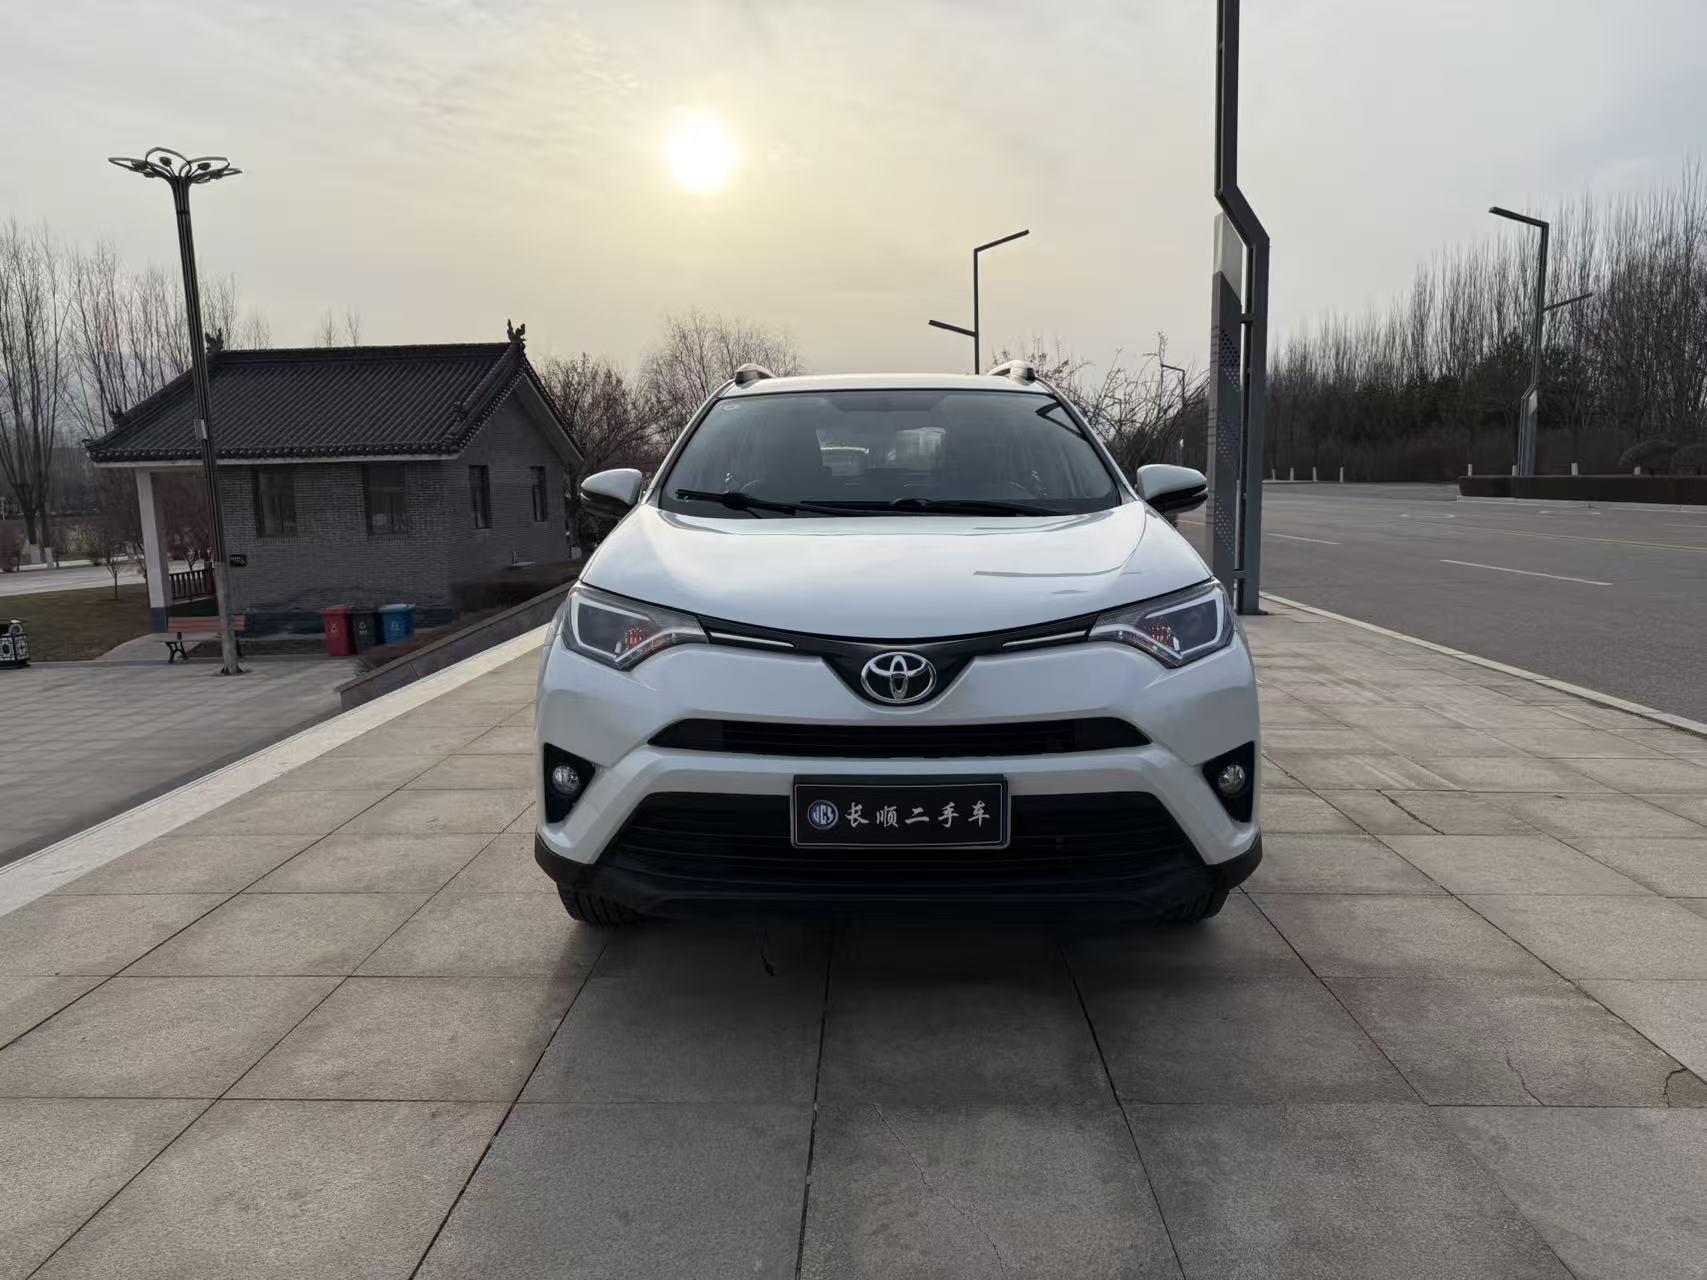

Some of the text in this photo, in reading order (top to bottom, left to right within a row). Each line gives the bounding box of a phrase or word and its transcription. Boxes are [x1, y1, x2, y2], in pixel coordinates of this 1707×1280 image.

[845, 802, 991, 827] 长顺二手车
